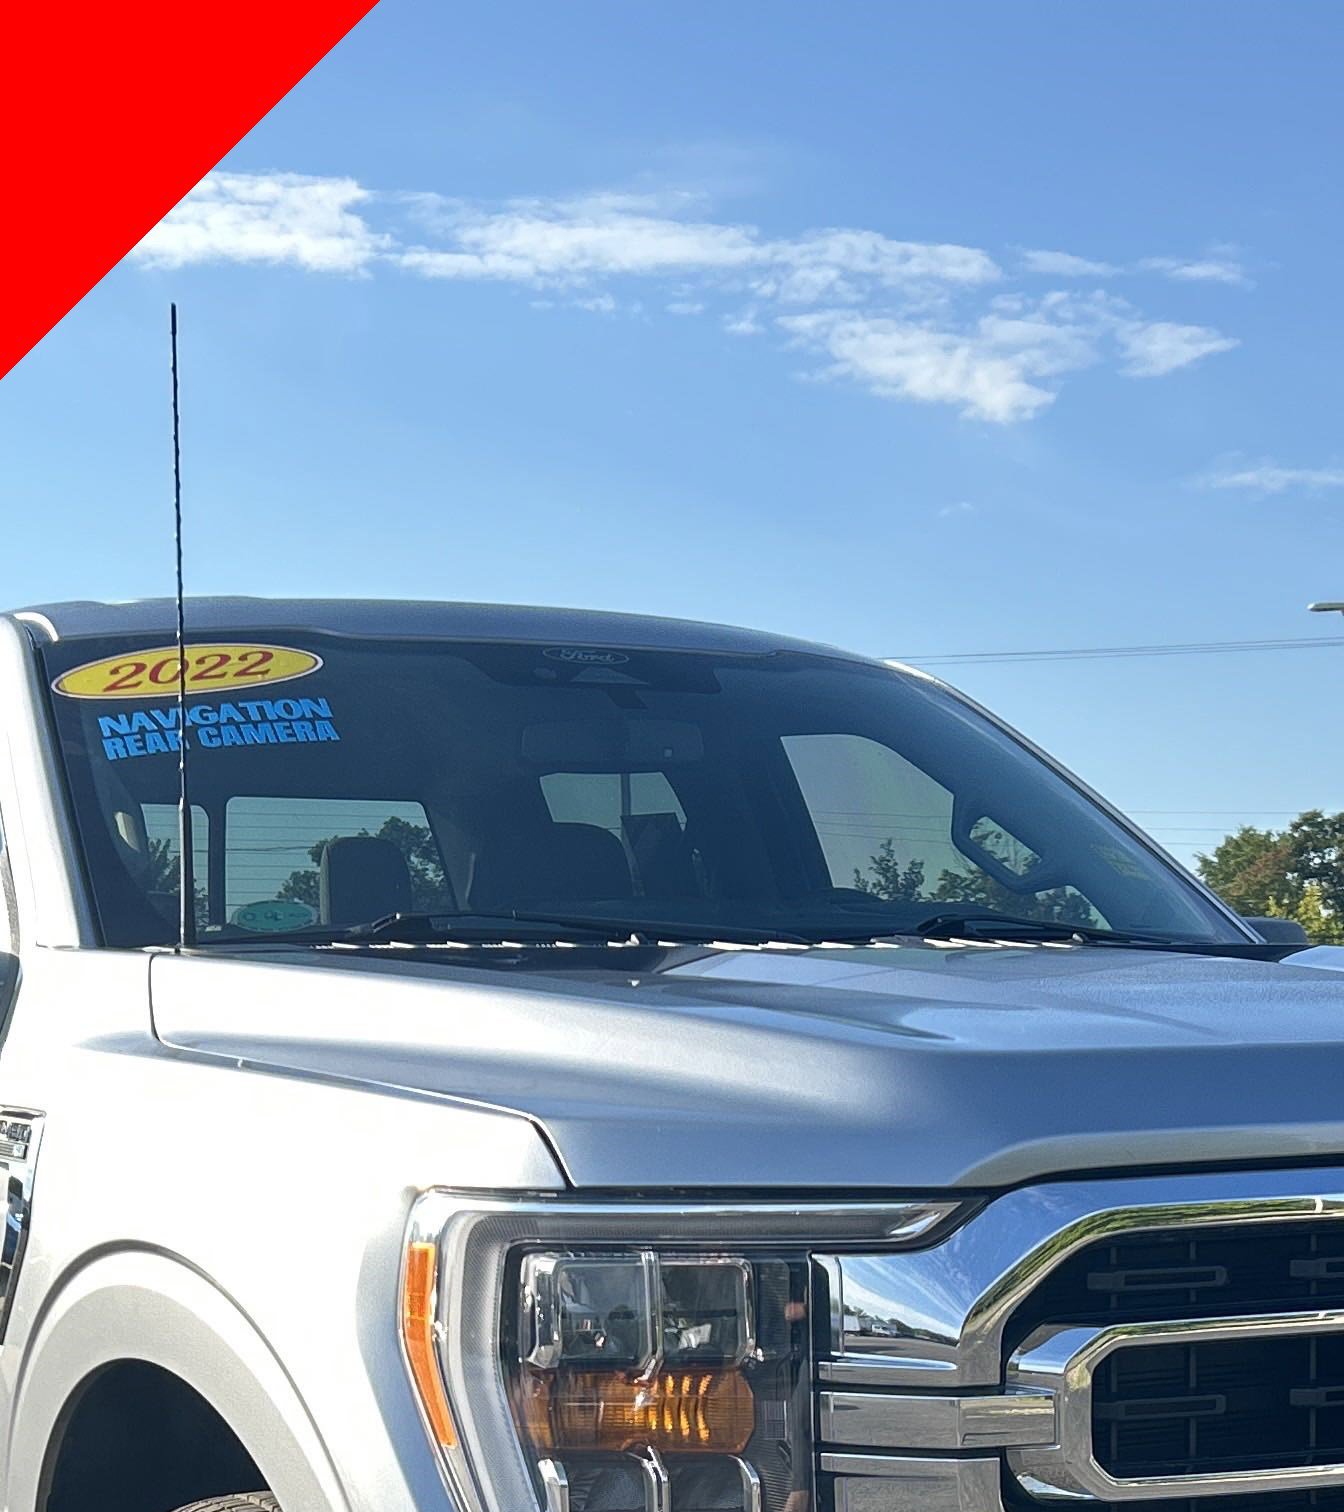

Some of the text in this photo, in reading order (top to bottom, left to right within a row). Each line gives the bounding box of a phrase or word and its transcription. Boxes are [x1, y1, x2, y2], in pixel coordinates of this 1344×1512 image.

[103, 650, 274, 693] 2022
[98, 697, 334, 738] NAVIGATION
[102, 720, 342, 762] REAR CAMERA
